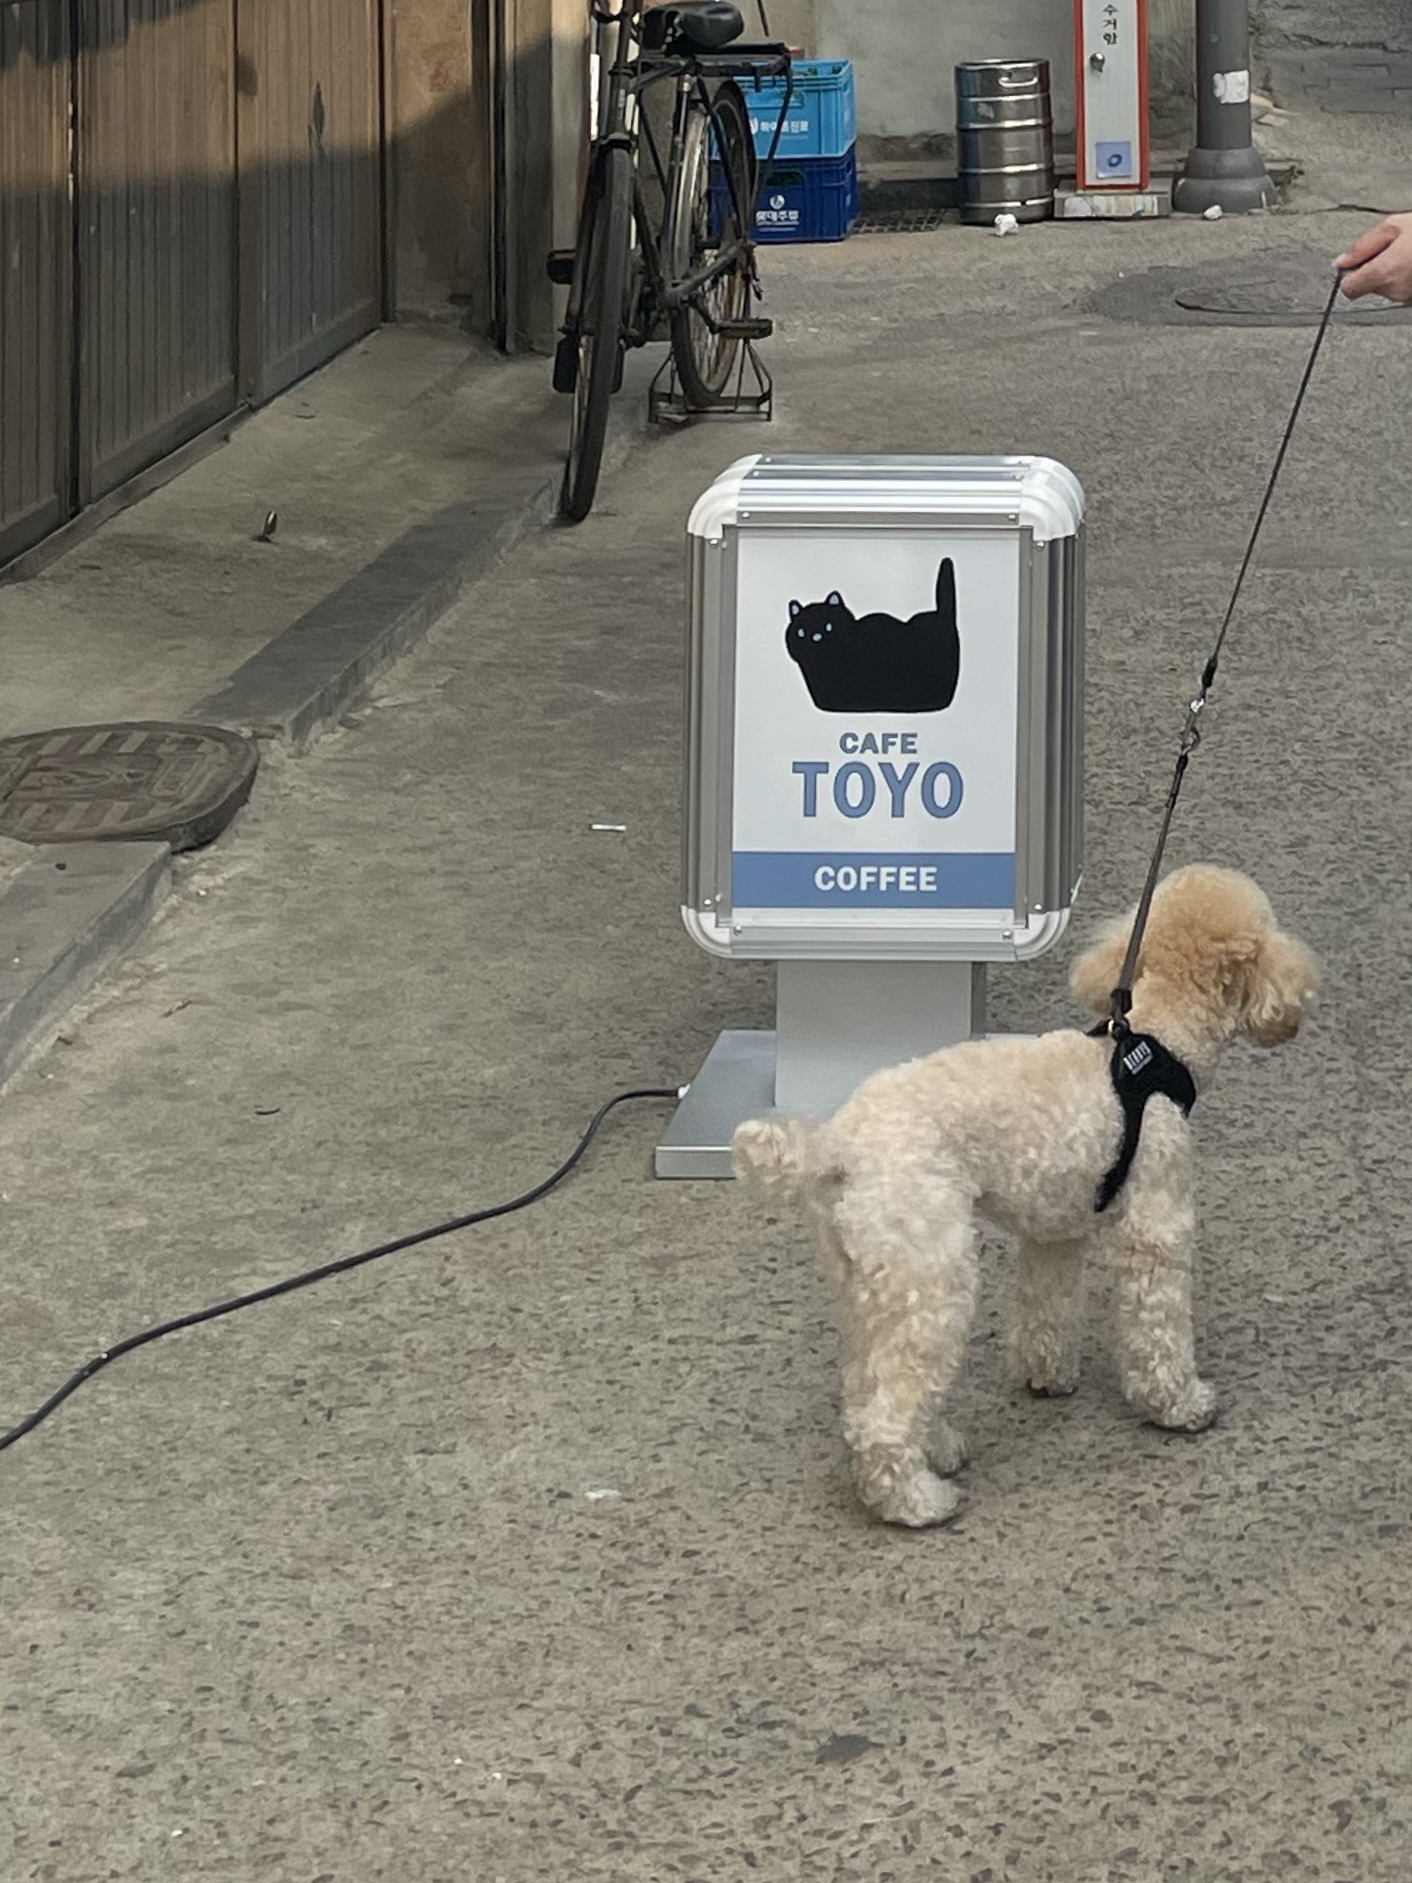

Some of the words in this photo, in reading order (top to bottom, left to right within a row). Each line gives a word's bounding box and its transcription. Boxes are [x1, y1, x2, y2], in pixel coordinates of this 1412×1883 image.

[838, 731, 919, 755] CAFE
[791, 760, 964, 820] TOYO
[813, 865, 938, 893] COFFEE
